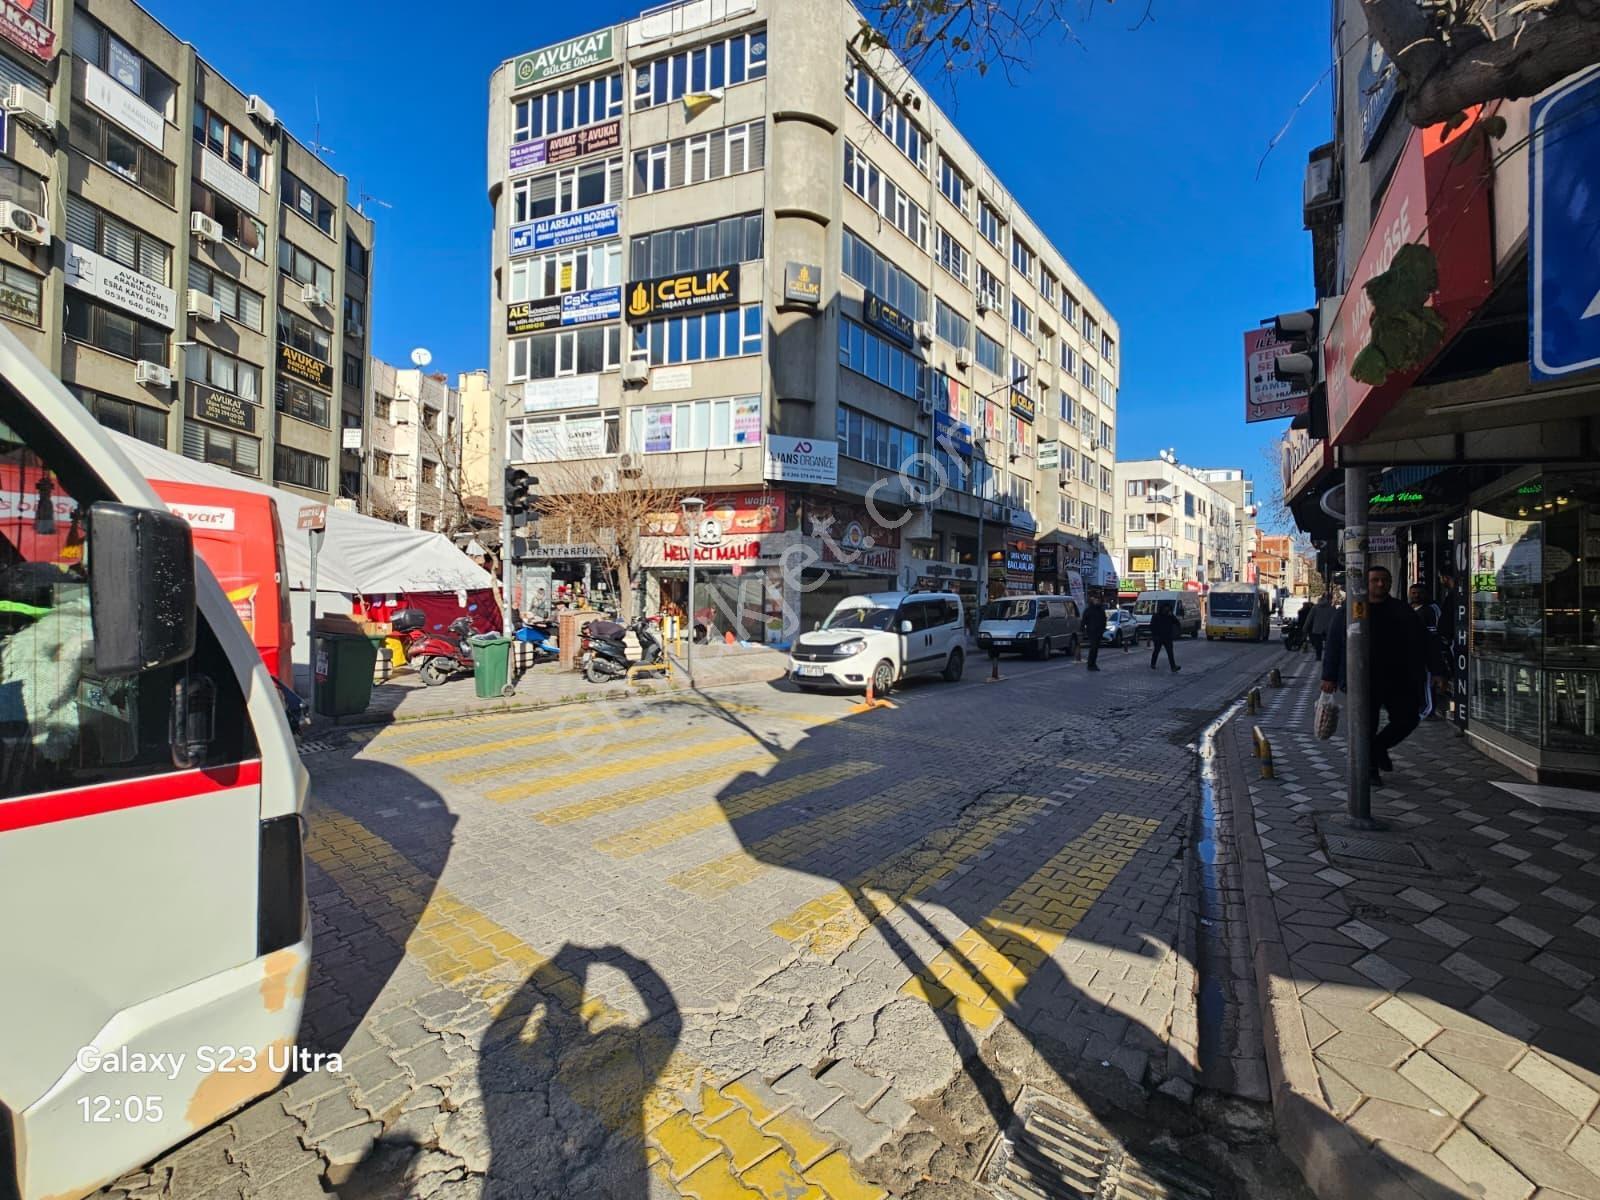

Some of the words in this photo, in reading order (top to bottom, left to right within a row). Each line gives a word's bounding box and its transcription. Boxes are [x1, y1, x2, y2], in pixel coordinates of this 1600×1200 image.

[534, 31, 608, 70] AVUKAT
[550, 214, 582, 231] ARSLAN
[583, 208, 616, 223] BOZBEY
[103, 278, 123, 292] ESRA
[125, 287, 143, 302] KAYA
[113, 275, 161, 300] ARABULUCU
[119, 271, 158, 292] AVUKAT
[509, 305, 529, 319] ALS
[283, 347, 325, 374] AVUKAT
[210, 393, 241, 408] AVUKAT
[768, 451, 799, 465] AJANS
[187, 508, 225, 523] var!
